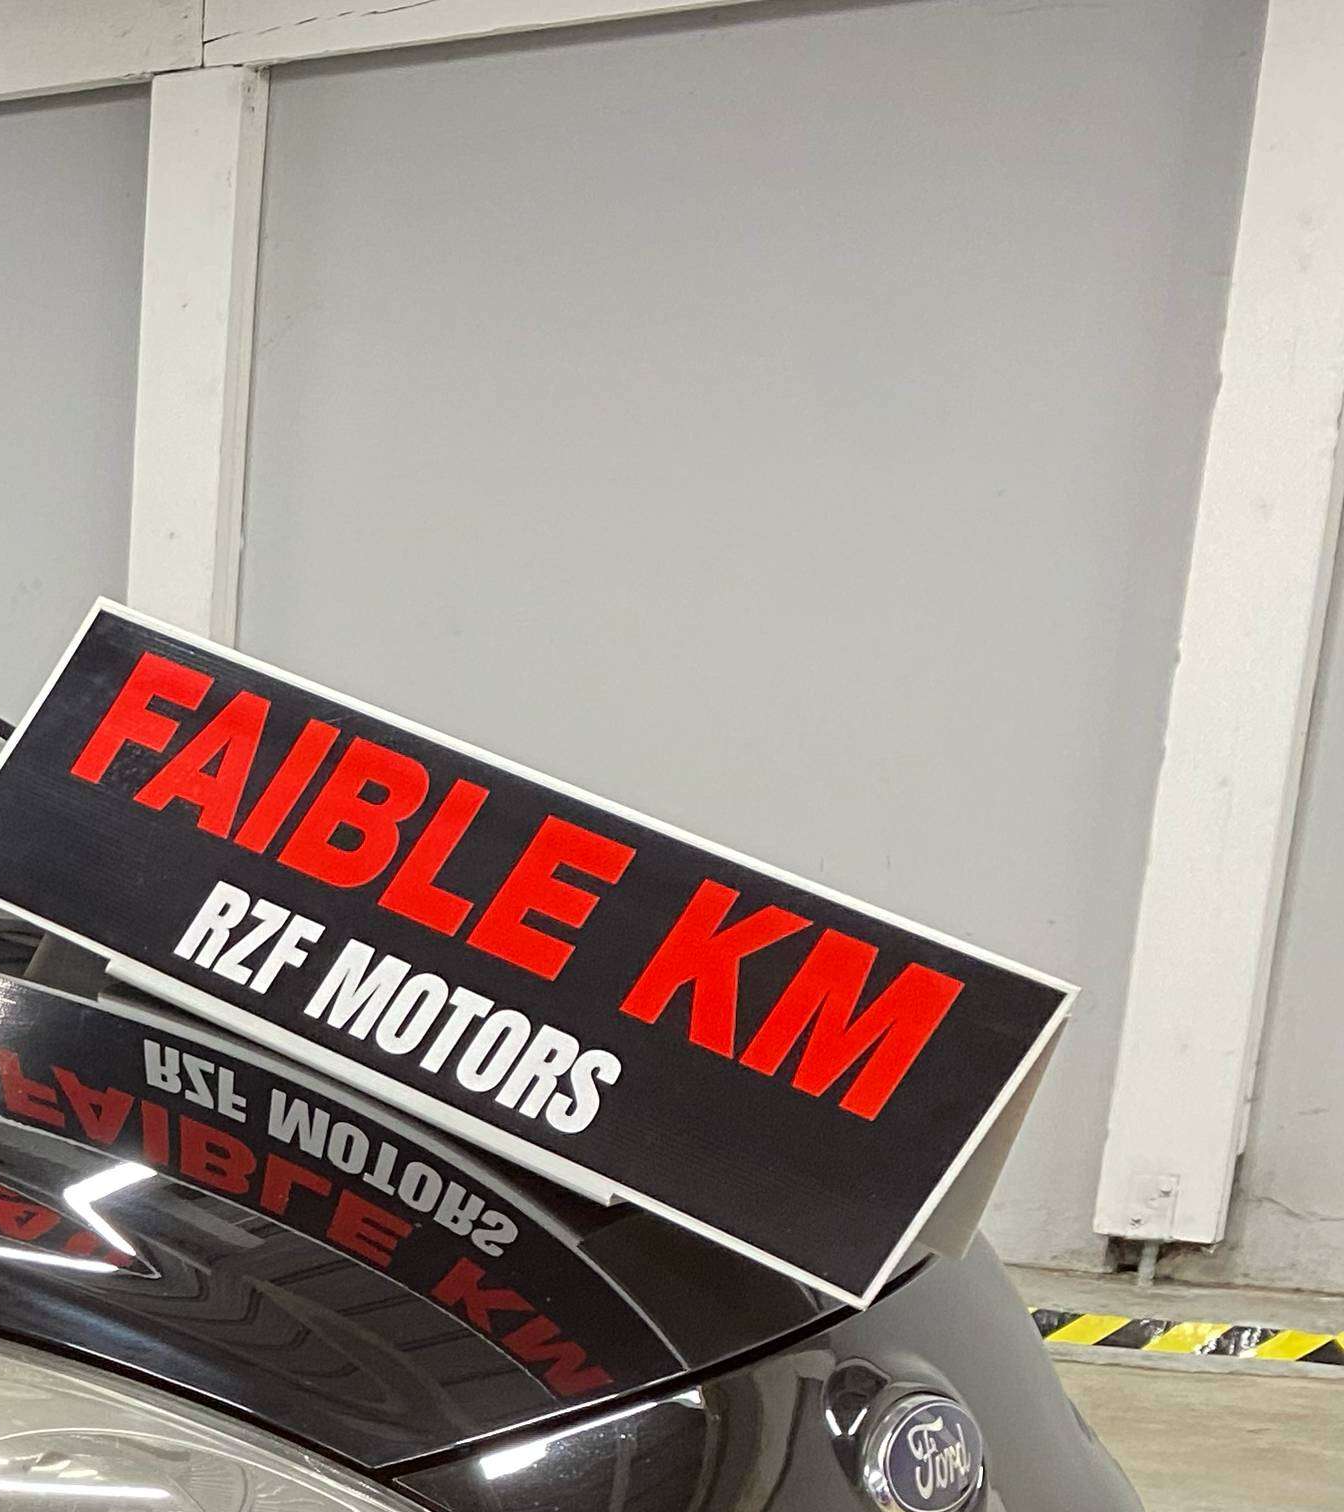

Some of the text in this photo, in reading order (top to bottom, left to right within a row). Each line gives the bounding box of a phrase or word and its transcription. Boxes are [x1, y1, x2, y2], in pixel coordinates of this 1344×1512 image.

[70, 650, 965, 1122] FAIBLE KM
[173, 881, 623, 1133] RZF MOTORS
[907, 1416, 971, 1499] Ford
